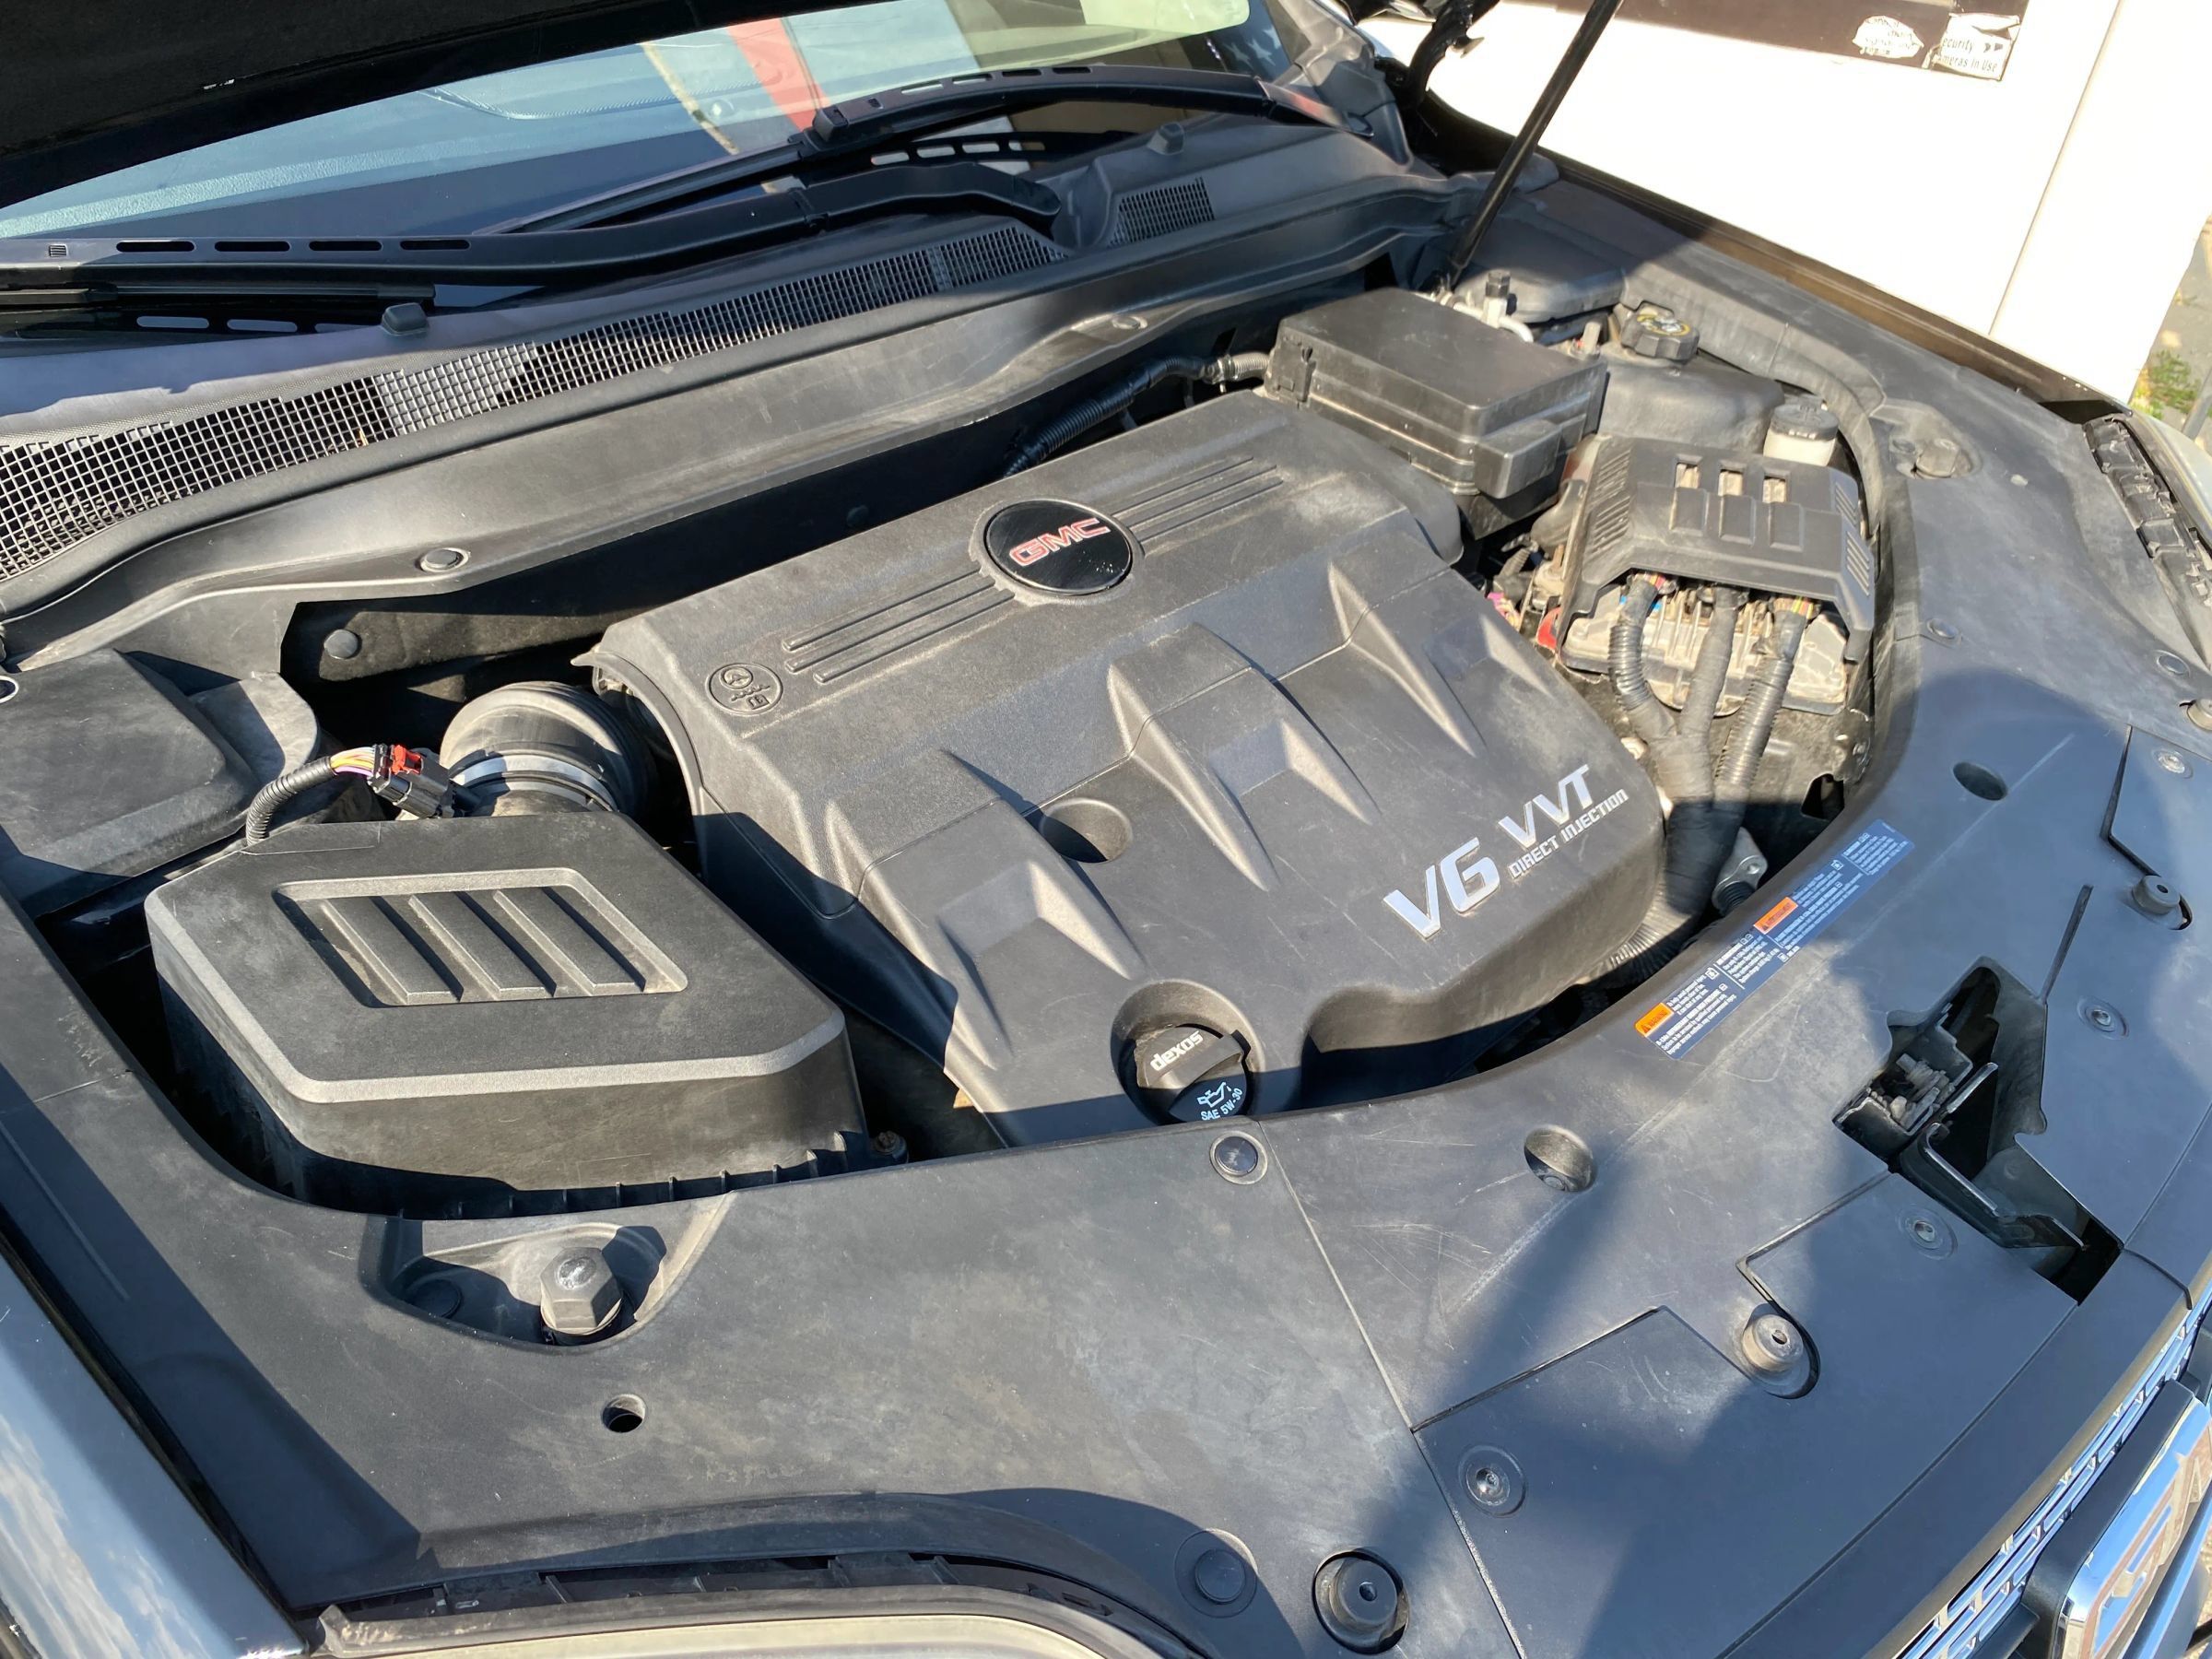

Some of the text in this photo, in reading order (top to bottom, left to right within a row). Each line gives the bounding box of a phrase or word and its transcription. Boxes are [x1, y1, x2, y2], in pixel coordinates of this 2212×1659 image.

[1938, 55, 1969, 67] meras
[1941, 38, 1972, 53] ecurity
[1009, 517, 1112, 567] GMC
[1382, 764, 1593, 939] V6 VVT
[1507, 788, 1630, 879] DIRECT INJECTION
[1149, 1030, 1204, 1071] dexos
[1200, 1088, 1243, 1122] SAE 5W-30
